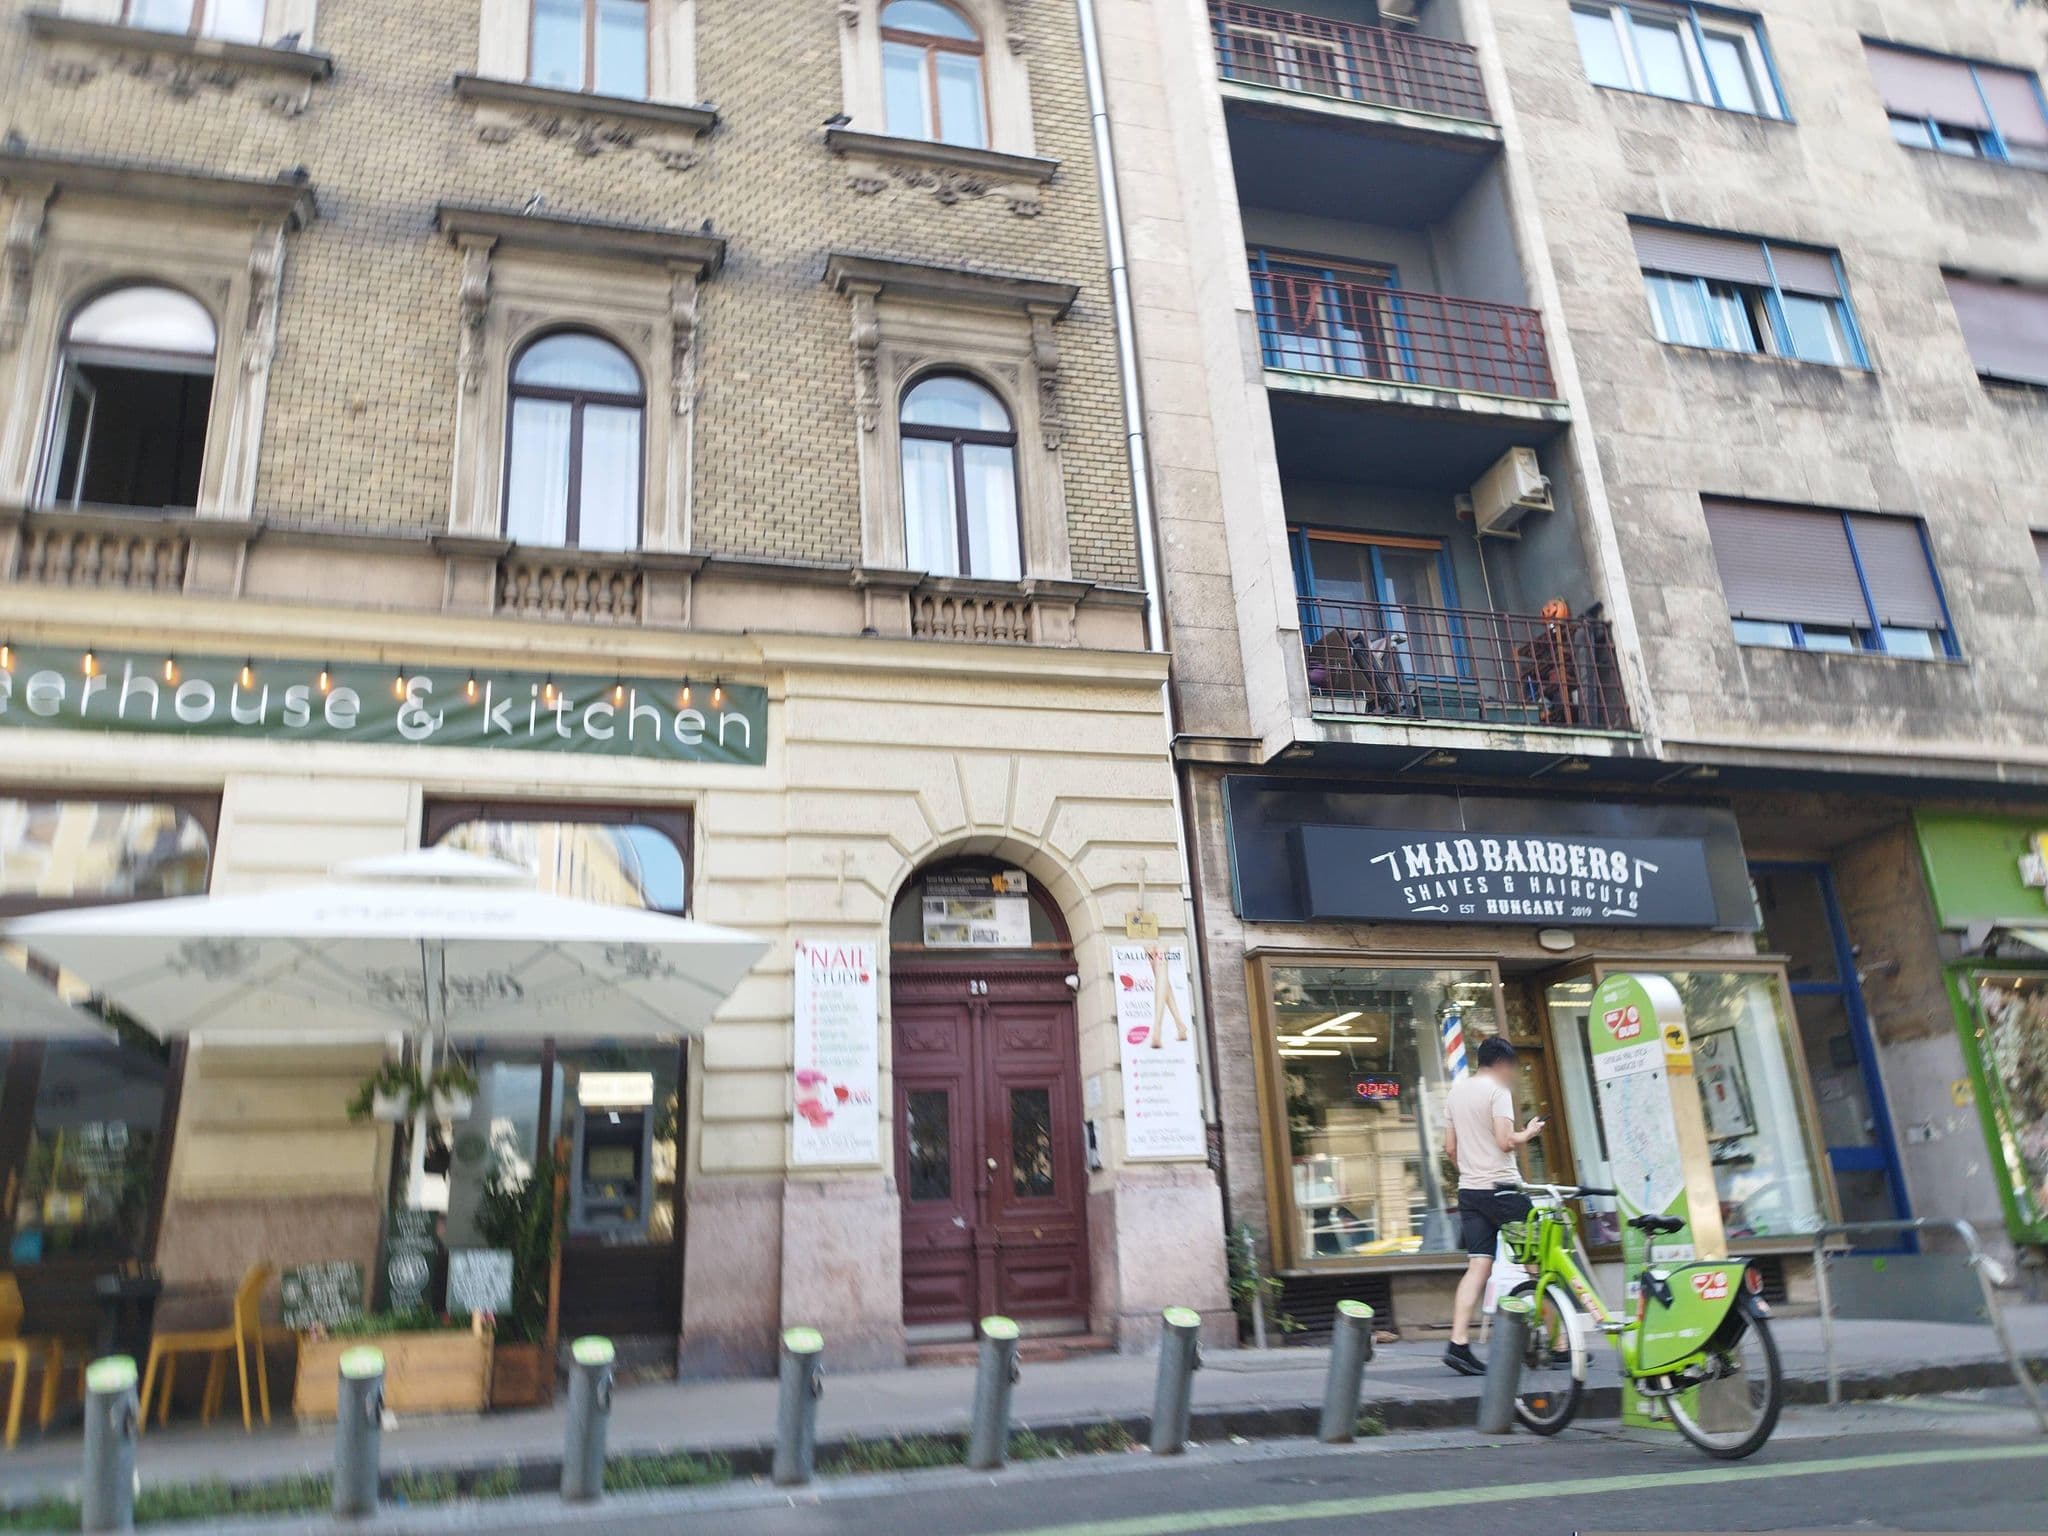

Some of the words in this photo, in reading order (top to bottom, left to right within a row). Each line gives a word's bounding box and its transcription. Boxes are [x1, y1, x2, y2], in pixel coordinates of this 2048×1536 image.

[396, 676, 444, 742] &
[482, 679, 751, 749] kitchen
[1401, 838, 1478, 878] MAD
[1480, 839, 1630, 884] BARBERS
[1403, 875, 1489, 905] SHAVES
[1503, 875, 1515, 893] &
[1530, 876, 1639, 911] HAIRCUTS
[1459, 903, 1476, 915] EST
[1486, 898, 1565, 916] HUNGARY
[810, 945, 866, 969] NAIL
[1355, 1082, 1400, 1096] OPEN
